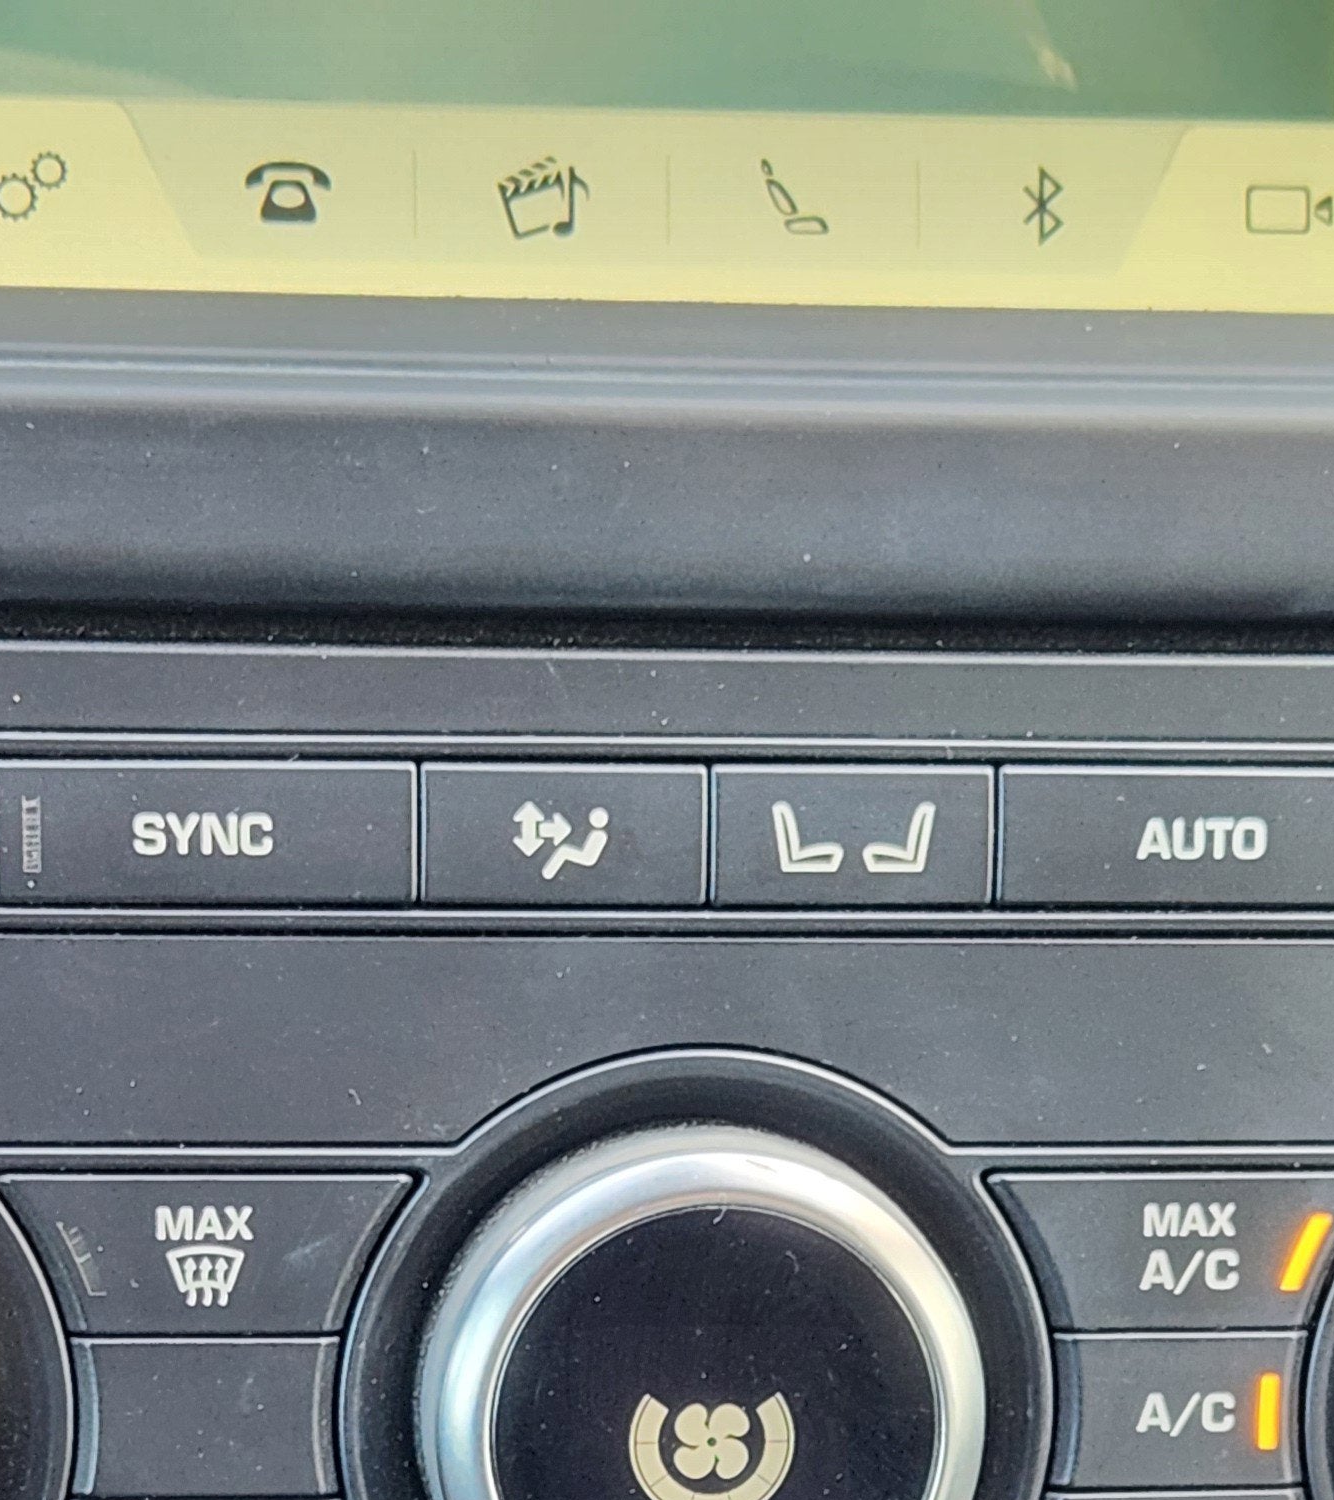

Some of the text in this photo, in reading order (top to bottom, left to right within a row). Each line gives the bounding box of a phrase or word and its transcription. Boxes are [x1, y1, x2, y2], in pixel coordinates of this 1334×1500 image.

[131, 811, 275, 856] SYNC
[1136, 817, 1268, 860] AUTO
[155, 1206, 254, 1241] MAX
[1142, 1202, 1237, 1237] MAX
[1139, 1248, 1240, 1295] A/C
[1135, 1392, 1237, 1437] A/C
